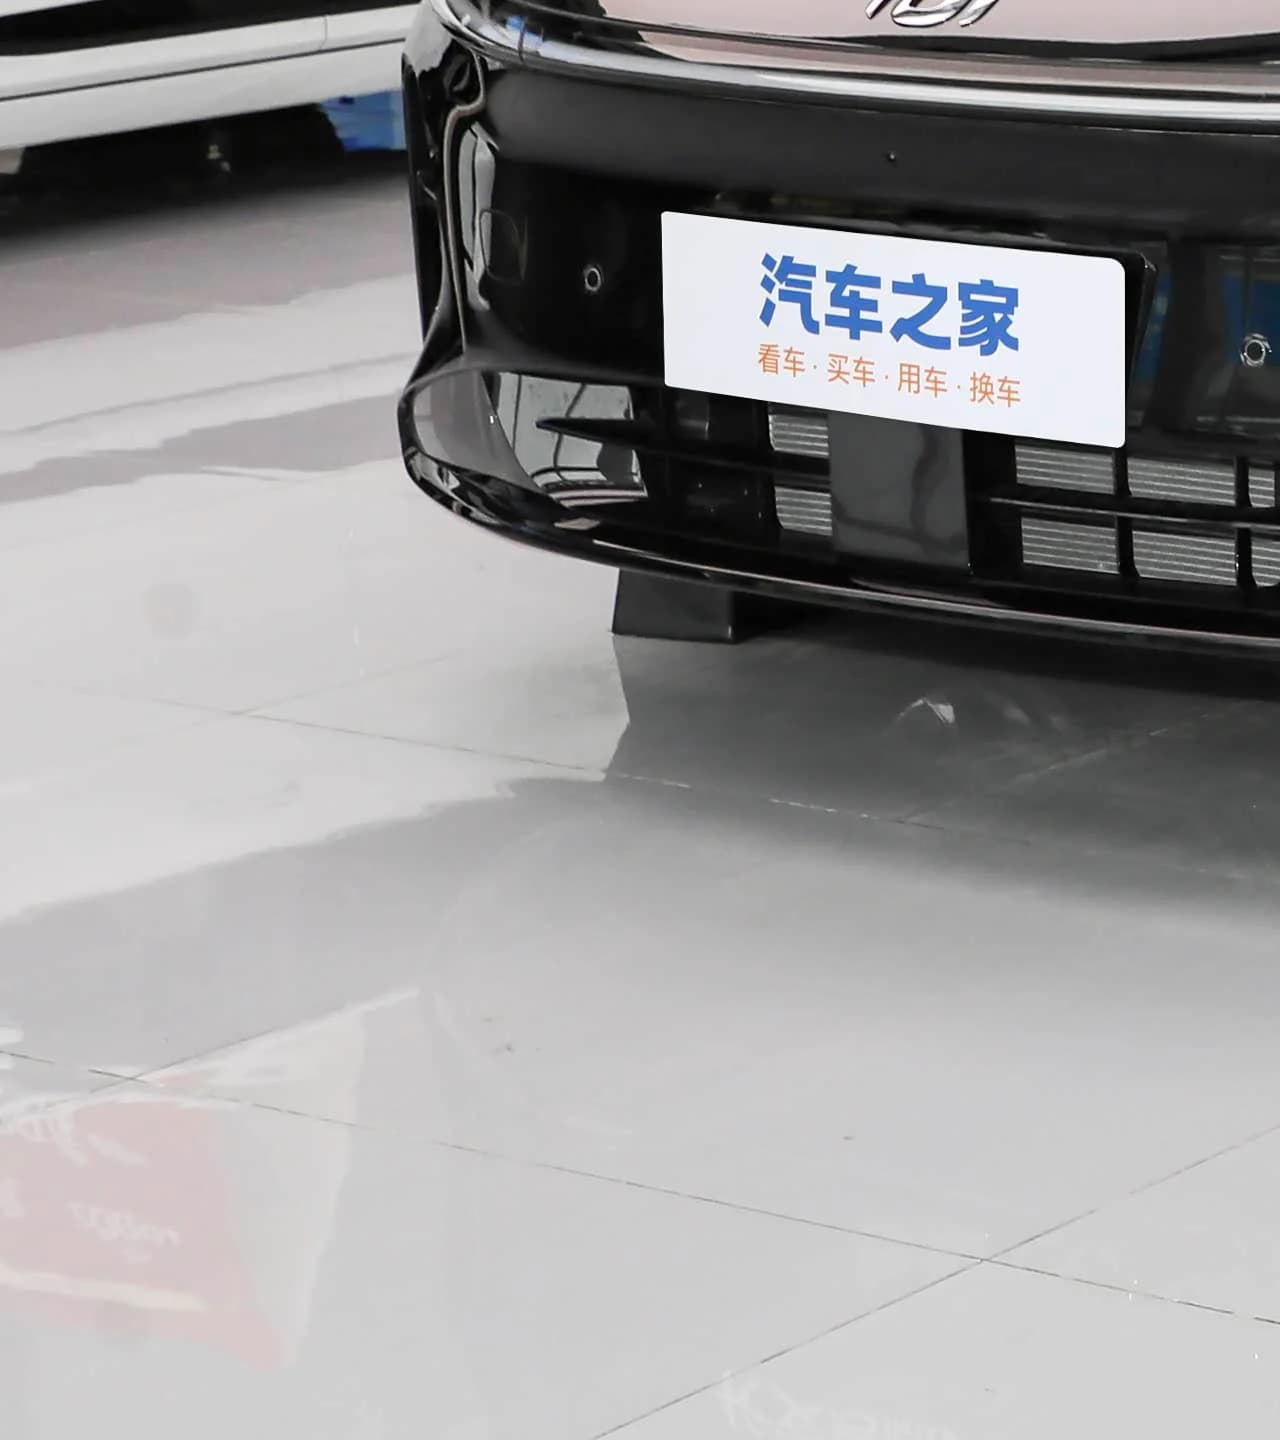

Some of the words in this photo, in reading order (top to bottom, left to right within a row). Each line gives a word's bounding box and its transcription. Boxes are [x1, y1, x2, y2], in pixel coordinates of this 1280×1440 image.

[760, 253, 1019, 357] 汽车之家
[758, 343, 806, 378] 看车
[827, 352, 876, 388] 买车
[898, 362, 948, 398] 用车
[969, 371, 1021, 408] 换车
